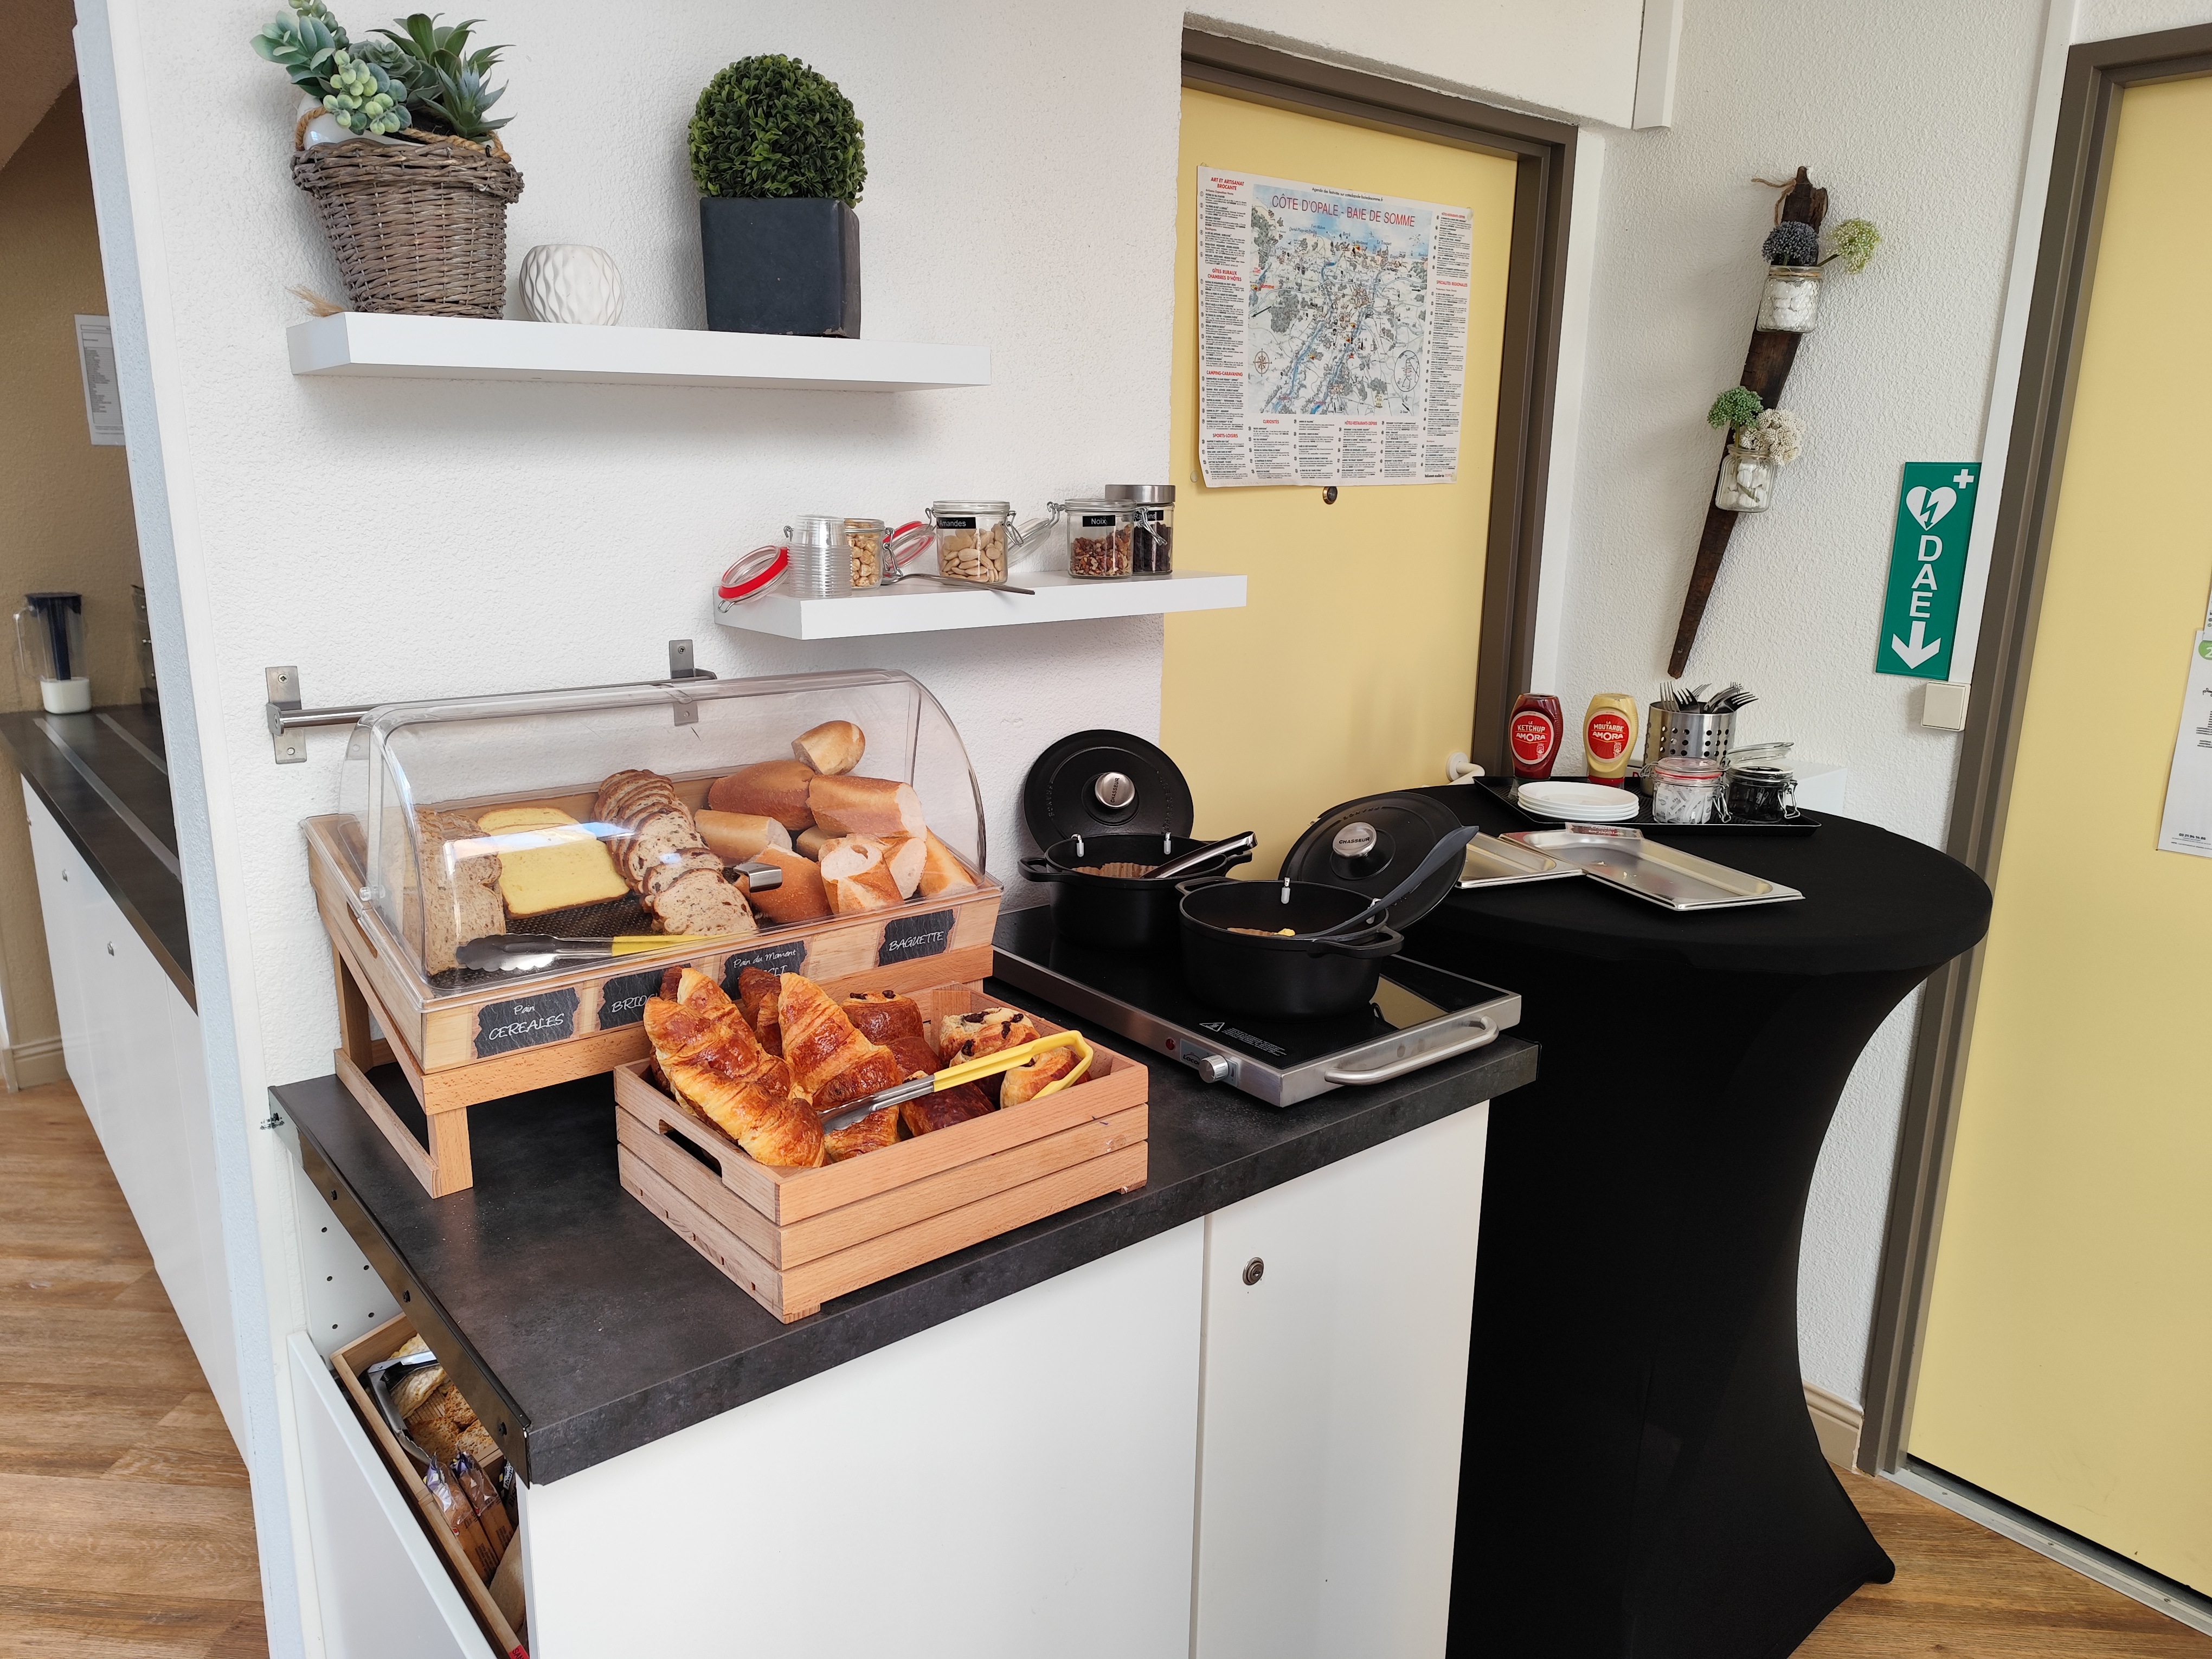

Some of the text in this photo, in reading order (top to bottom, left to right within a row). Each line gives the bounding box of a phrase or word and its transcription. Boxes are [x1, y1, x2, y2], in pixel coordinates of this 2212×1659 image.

[1272, 193, 1298, 210] CÔTE
[1302, 199, 1339, 216] D'OPALE
[1347, 207, 1367, 221] BAIE
[1369, 210, 1381, 222] DE
[1384, 212, 1416, 227] SOMME
[1910, 534, 1943, 619] DAE
[1516, 732, 1546, 742] AMORA
[1517, 724, 1546, 733] KETCHUP
[1592, 731, 1624, 741] AMORA
[1593, 724, 1624, 732] MOUTARDE
[1110, 777, 1120, 803] CHASSEUR
[889, 931, 944, 951] BAGUETTE
[733, 949, 796, 968] Pain du Moment
[513, 1005, 536, 1015] Pain
[488, 1013, 564, 1040] CEREALES
